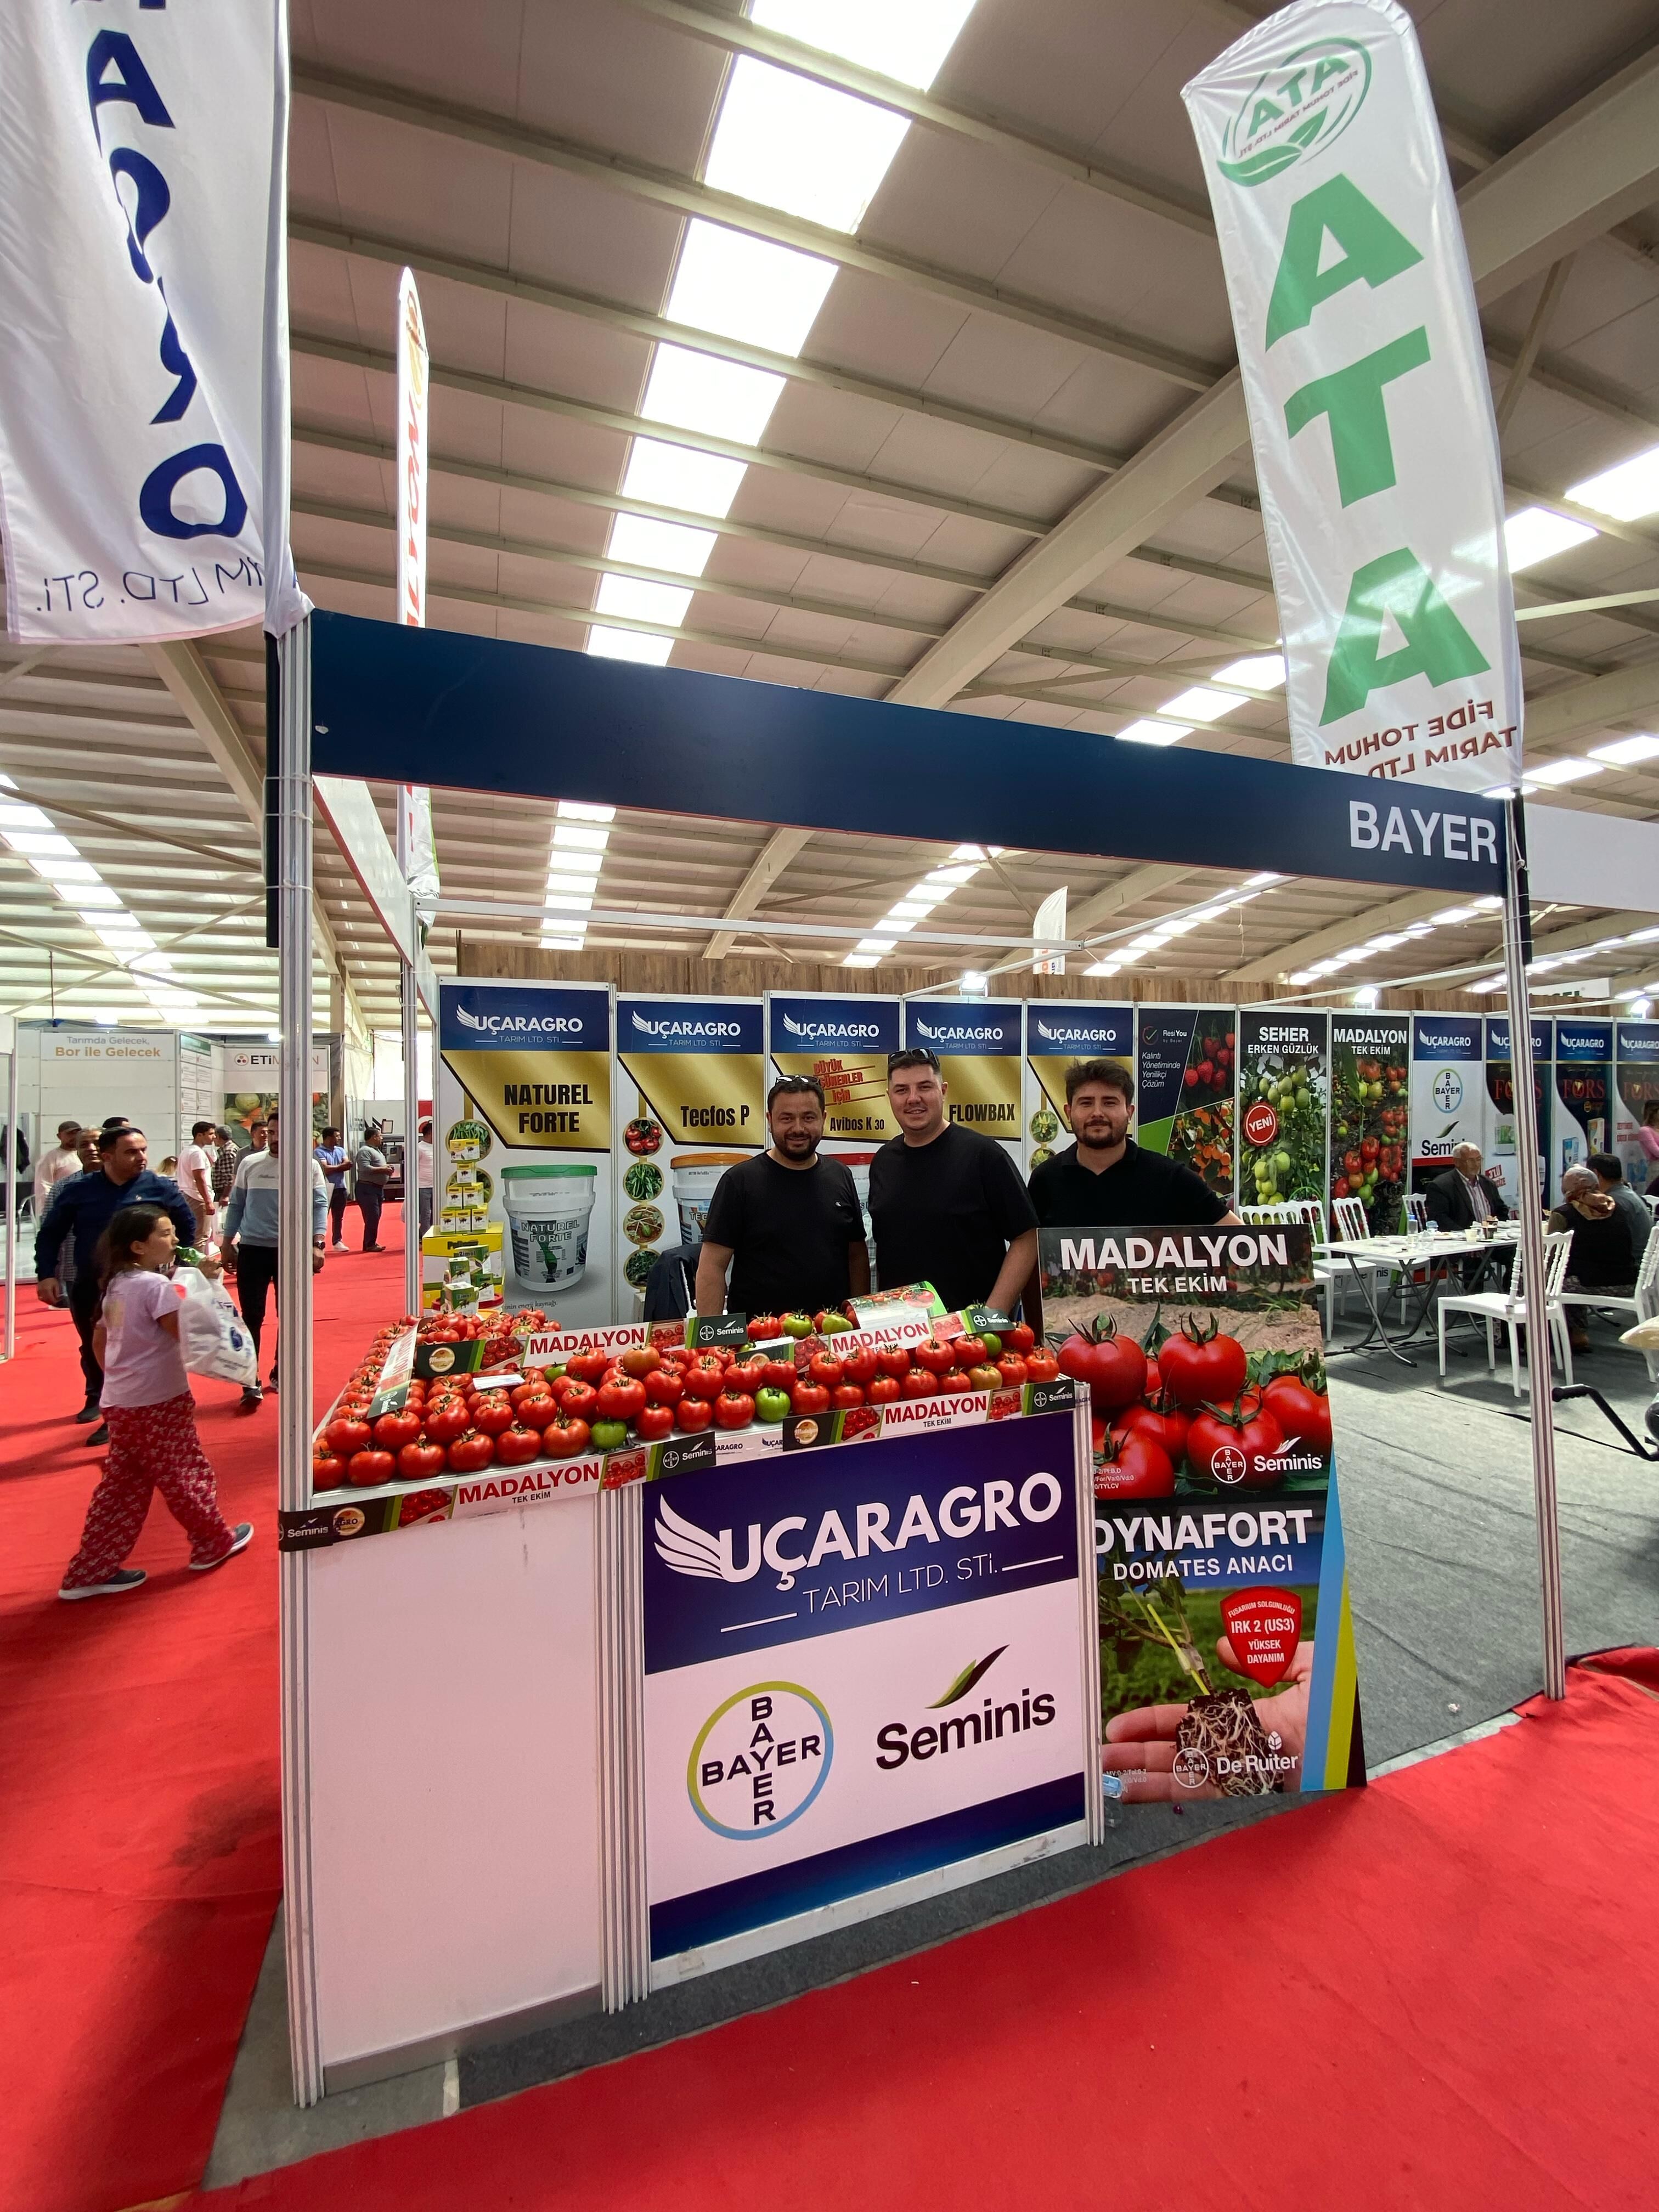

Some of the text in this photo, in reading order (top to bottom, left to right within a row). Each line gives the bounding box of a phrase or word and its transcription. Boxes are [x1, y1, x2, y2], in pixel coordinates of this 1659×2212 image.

[1348, 800, 1498, 865] BAYER
[475, 1016, 583, 1035] UÇARAGRO
[648, 1021, 741, 1039] UÇARAGRO
[797, 1023, 879, 1040] UÇARAGRO
[1259, 1026, 1309, 1042] SEHER
[67, 1036, 106, 1045] Tarımda
[929, 1027, 1003, 1043] UÇARAGRO
[1048, 1029, 1116, 1043] UÇARAGRO
[1334, 1028, 1407, 1043] MADALYON
[1426, 1036, 1471, 1049] UÇARAGRO
[55, 1047, 161, 1057] Bor ile Gelecek
[1248, 1044, 1319, 1054] ERKEN GÜZLÜK
[1351, 1045, 1391, 1055] TEK EKİM
[1567, 1039, 1605, 1050] UÇARAGRO
[813, 1059, 843, 1074] BÜYÜK
[1142, 1070, 1167, 1079] Yenilikçi
[1142, 1080, 1165, 1089] Çözüm
[504, 1084, 593, 1106] NATUREL
[680, 1104, 750, 1128] Tecfos P
[949, 1103, 1015, 1122] FLOWBAX
[518, 1111, 580, 1134] FORTE
[830, 1116, 884, 1131] Avibos K 30
[1248, 1113, 1273, 1133] YENİ
[521, 1220, 580, 1232] NATUREL
[530, 1232, 572, 1243] FORTE
[1060, 1234, 1288, 1270] MADALYON
[1127, 1272, 1228, 1294] TEK EKİM
[716, 1327, 744, 1336] Seminis
[832, 1323, 929, 1353] MADALYON
[530, 1328, 645, 1355] MADALYON
[1048, 1392, 1073, 1402] Seminis
[885, 1396, 987, 1424] MADALYON
[937, 1418, 952, 1426] EKİM
[682, 1448, 713, 1460] Seminis
[1254, 1454, 1322, 1472] Seminis
[1224, 1449, 1233, 1481] BAYER
[459, 1462, 599, 1504] MADALYON
[512, 1491, 551, 1504] TEK EKİM
[287, 1526, 329, 1538] Seminis
[718, 1472, 1062, 1591] UÇARAGRO
[1094, 1509, 1313, 1554] DYNAFORT
[1113, 1554, 1293, 1581] DOMATES ANACI
[802, 1574, 889, 1615] TARIM
[898, 1565, 950, 1595] LTD.
[1228, 1600, 1295, 1618] FUSARIUM SOLGUNLUĞU
[1231, 1617, 1295, 1635] IRK 2 (US3)
[1248, 1639, 1281, 1651] YÜKSEK
[1246, 1652, 1285, 1664] DAYANIM
[876, 1688, 1057, 1770] Seminis
[702, 1734, 821, 1787] BAYER
[750, 1695, 776, 1826] BAYER
[1176, 1753, 1298, 1774] BAYER De Ruiter
